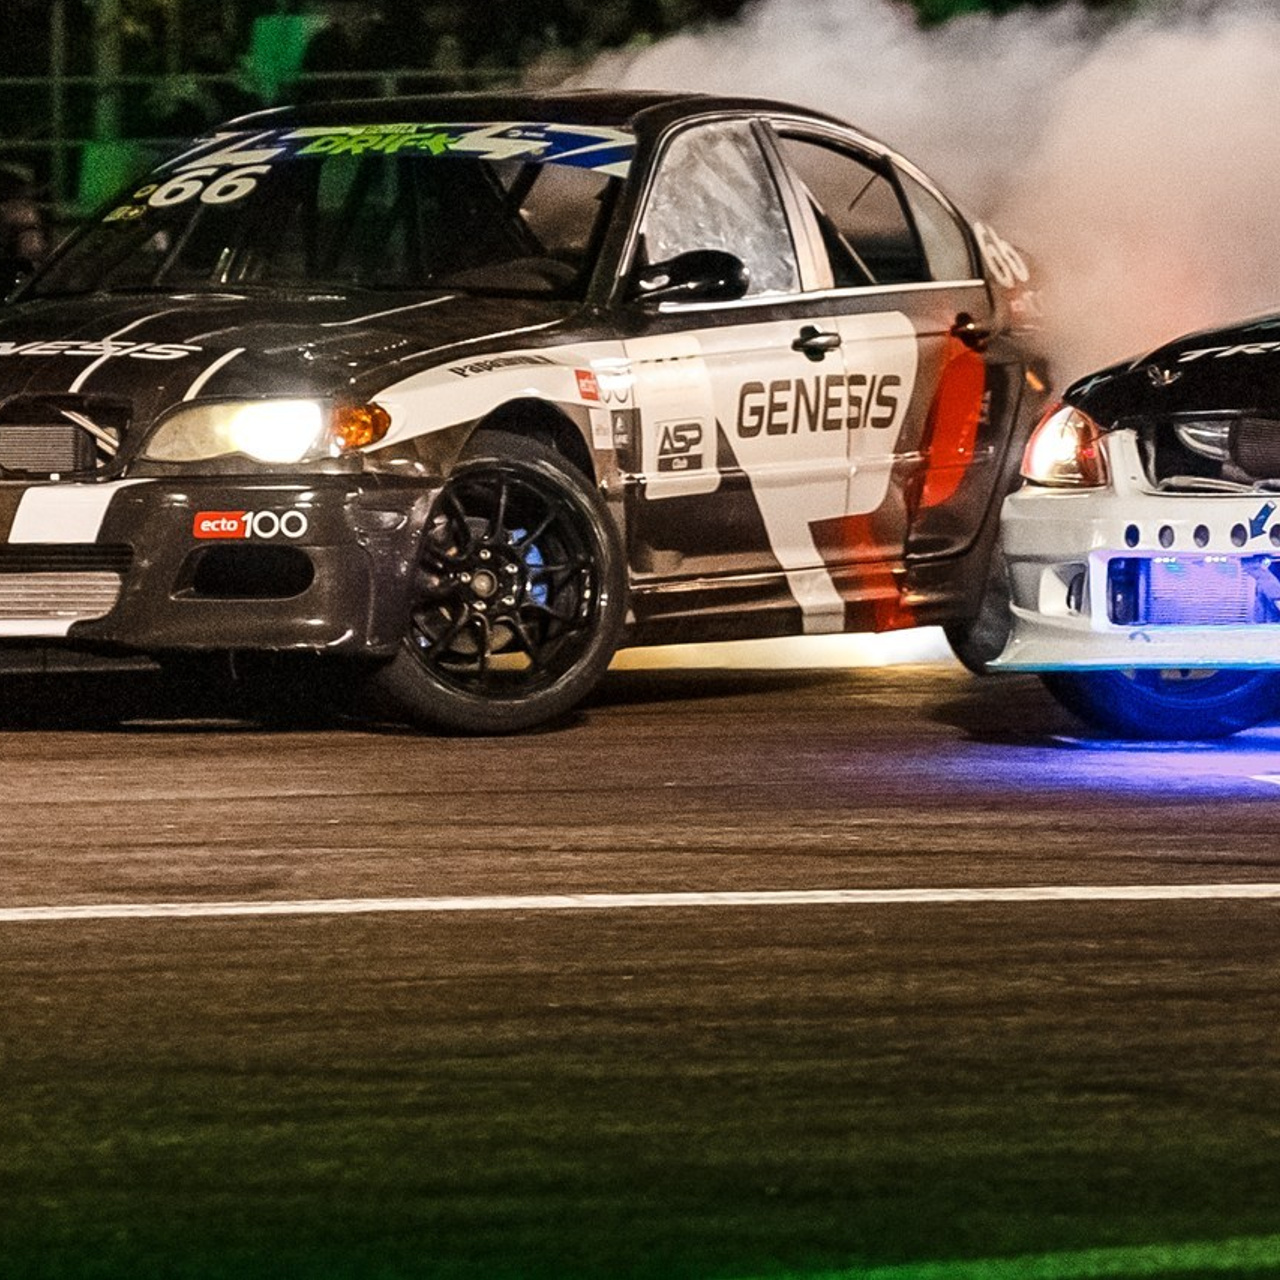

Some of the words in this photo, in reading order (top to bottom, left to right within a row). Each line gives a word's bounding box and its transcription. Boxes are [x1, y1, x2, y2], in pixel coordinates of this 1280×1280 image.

[148, 165, 272, 207] 66
[737, 373, 901, 439] GENESIS
[659, 422, 703, 456] ASP
